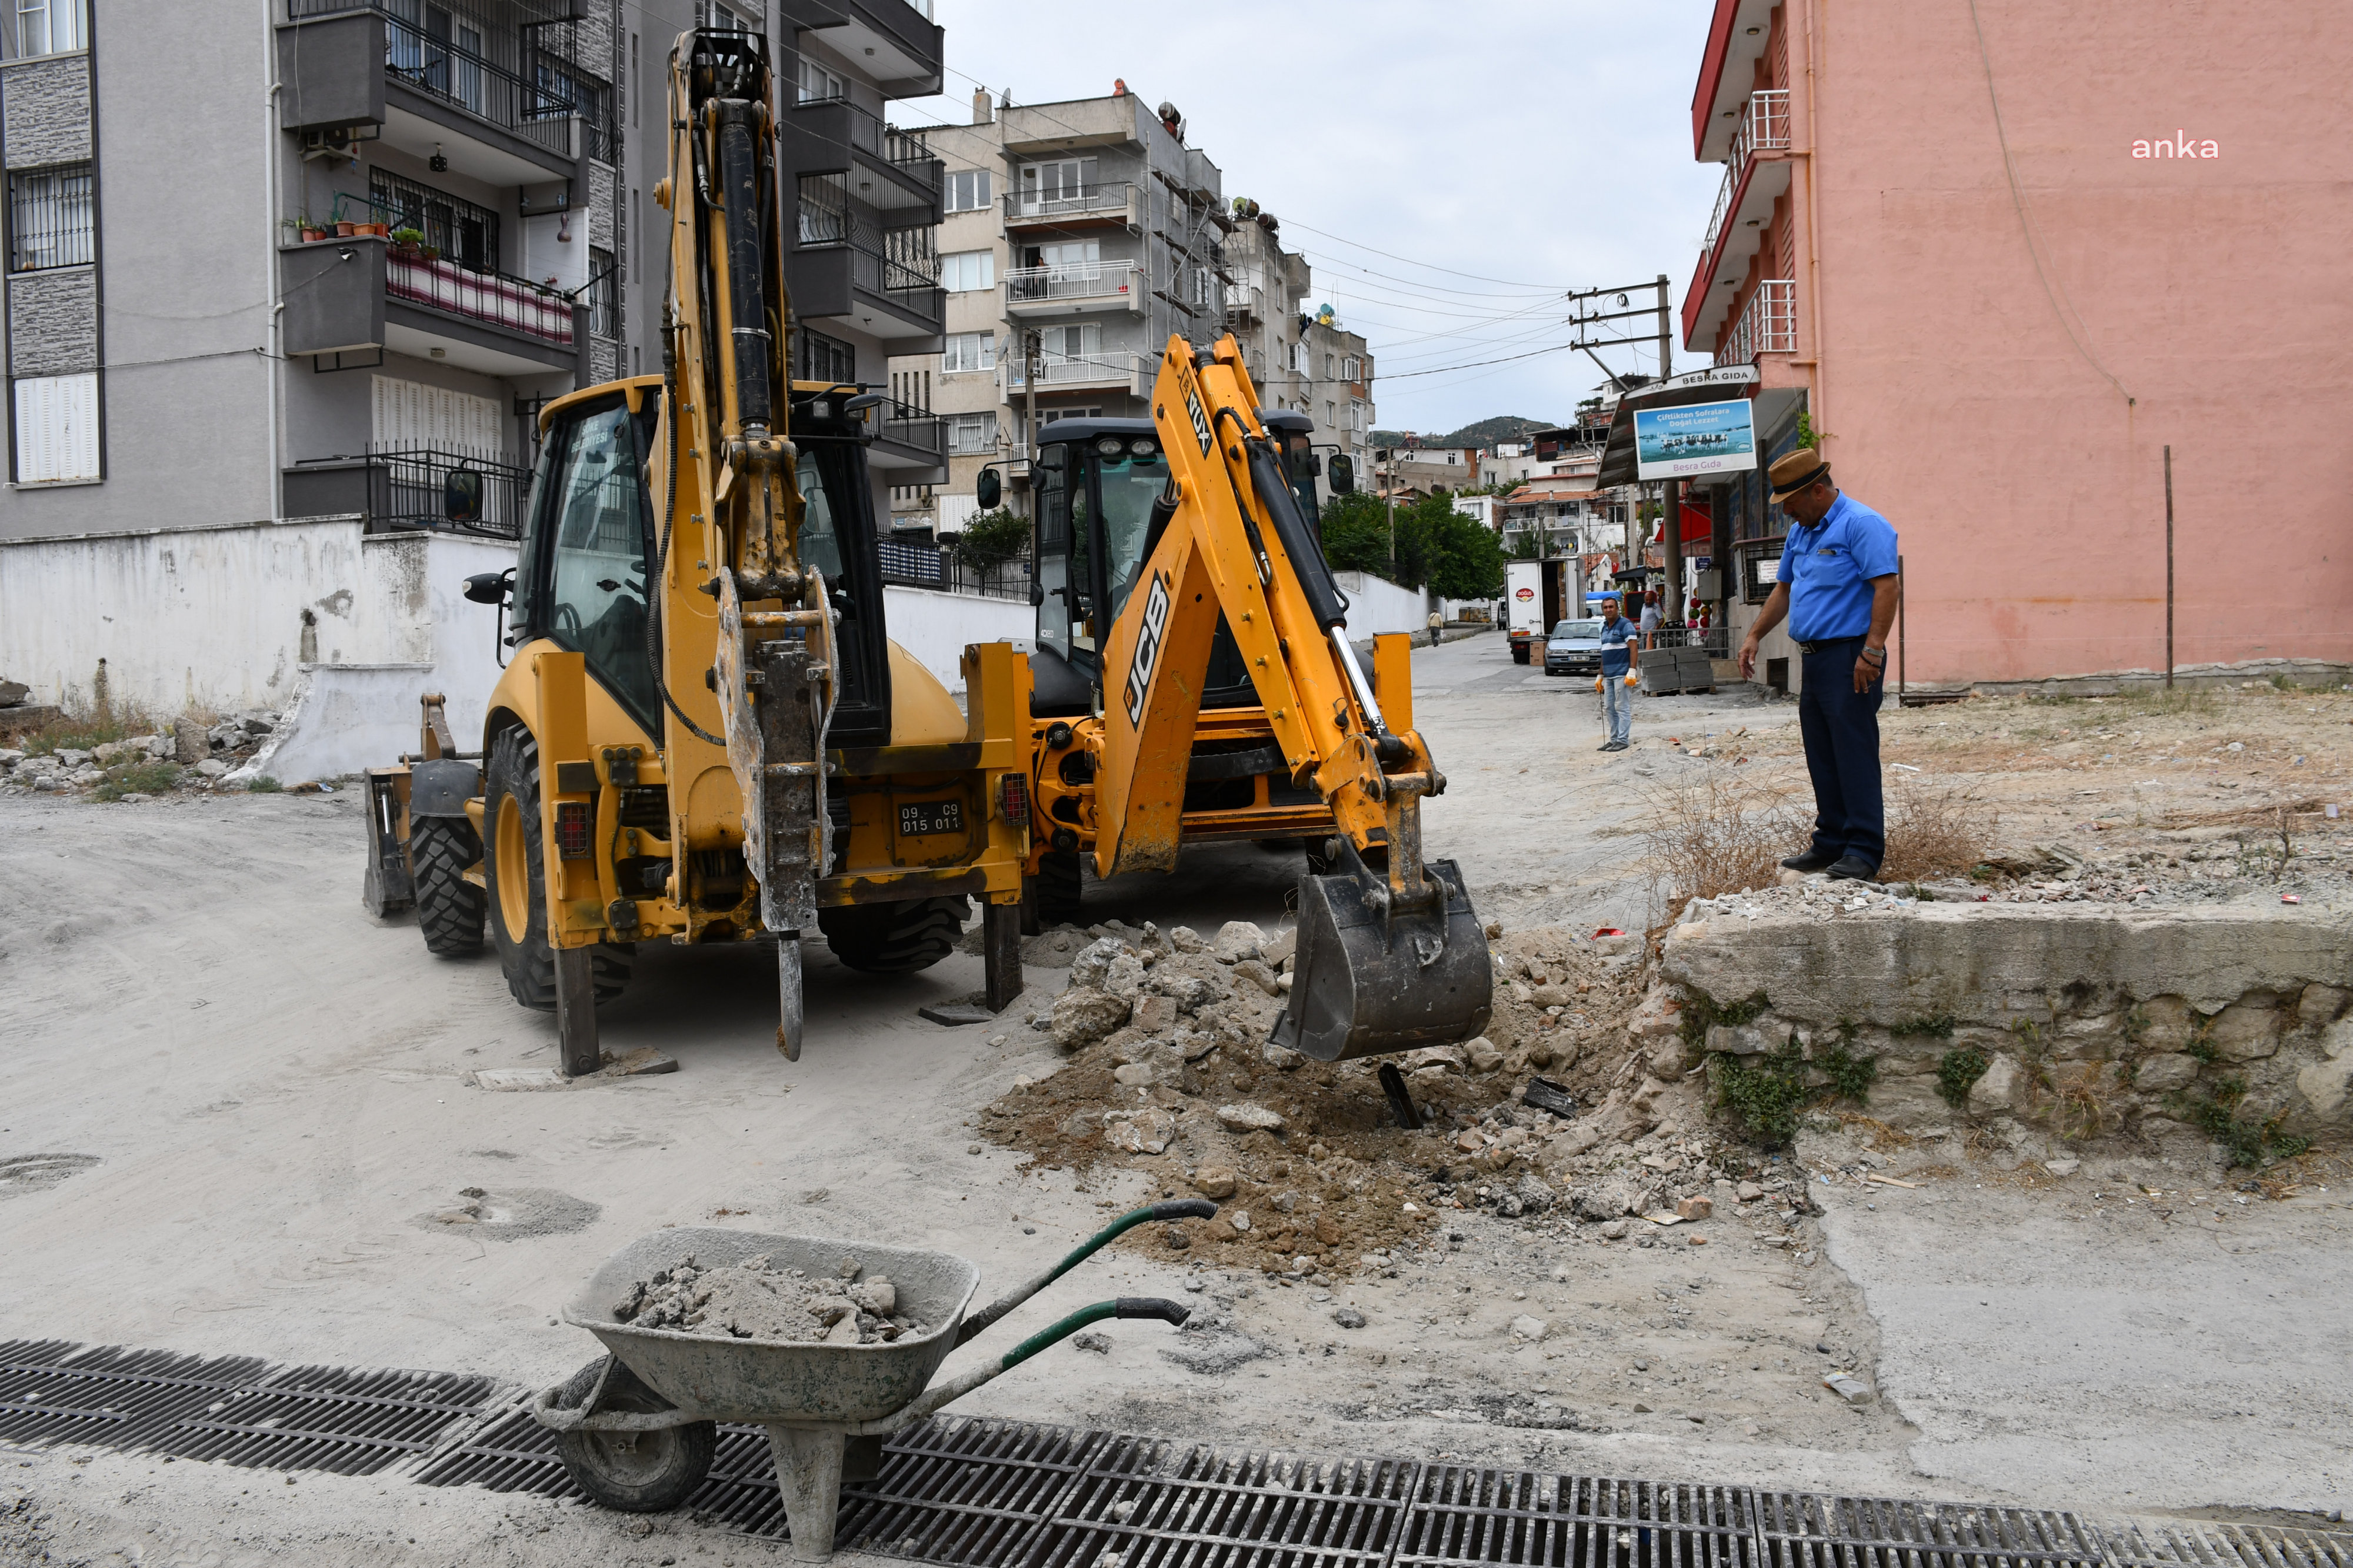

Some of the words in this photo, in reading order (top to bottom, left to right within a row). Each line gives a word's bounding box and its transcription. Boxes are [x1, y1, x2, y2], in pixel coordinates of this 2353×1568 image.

[1682, 373, 1718, 385] BESRA
[1722, 372, 1749, 380] GIDA
[1657, 412, 1694, 422] Çiftlikten
[1695, 408, 1729, 418] Sofralara
[1189, 391, 1210, 454] 4CX
[1701, 460, 1721, 469] Gıda
[1130, 579, 1167, 723] JCB
[902, 807, 918, 819] 09
[903, 819, 928, 832] 015
[935, 817, 958, 829] 011
